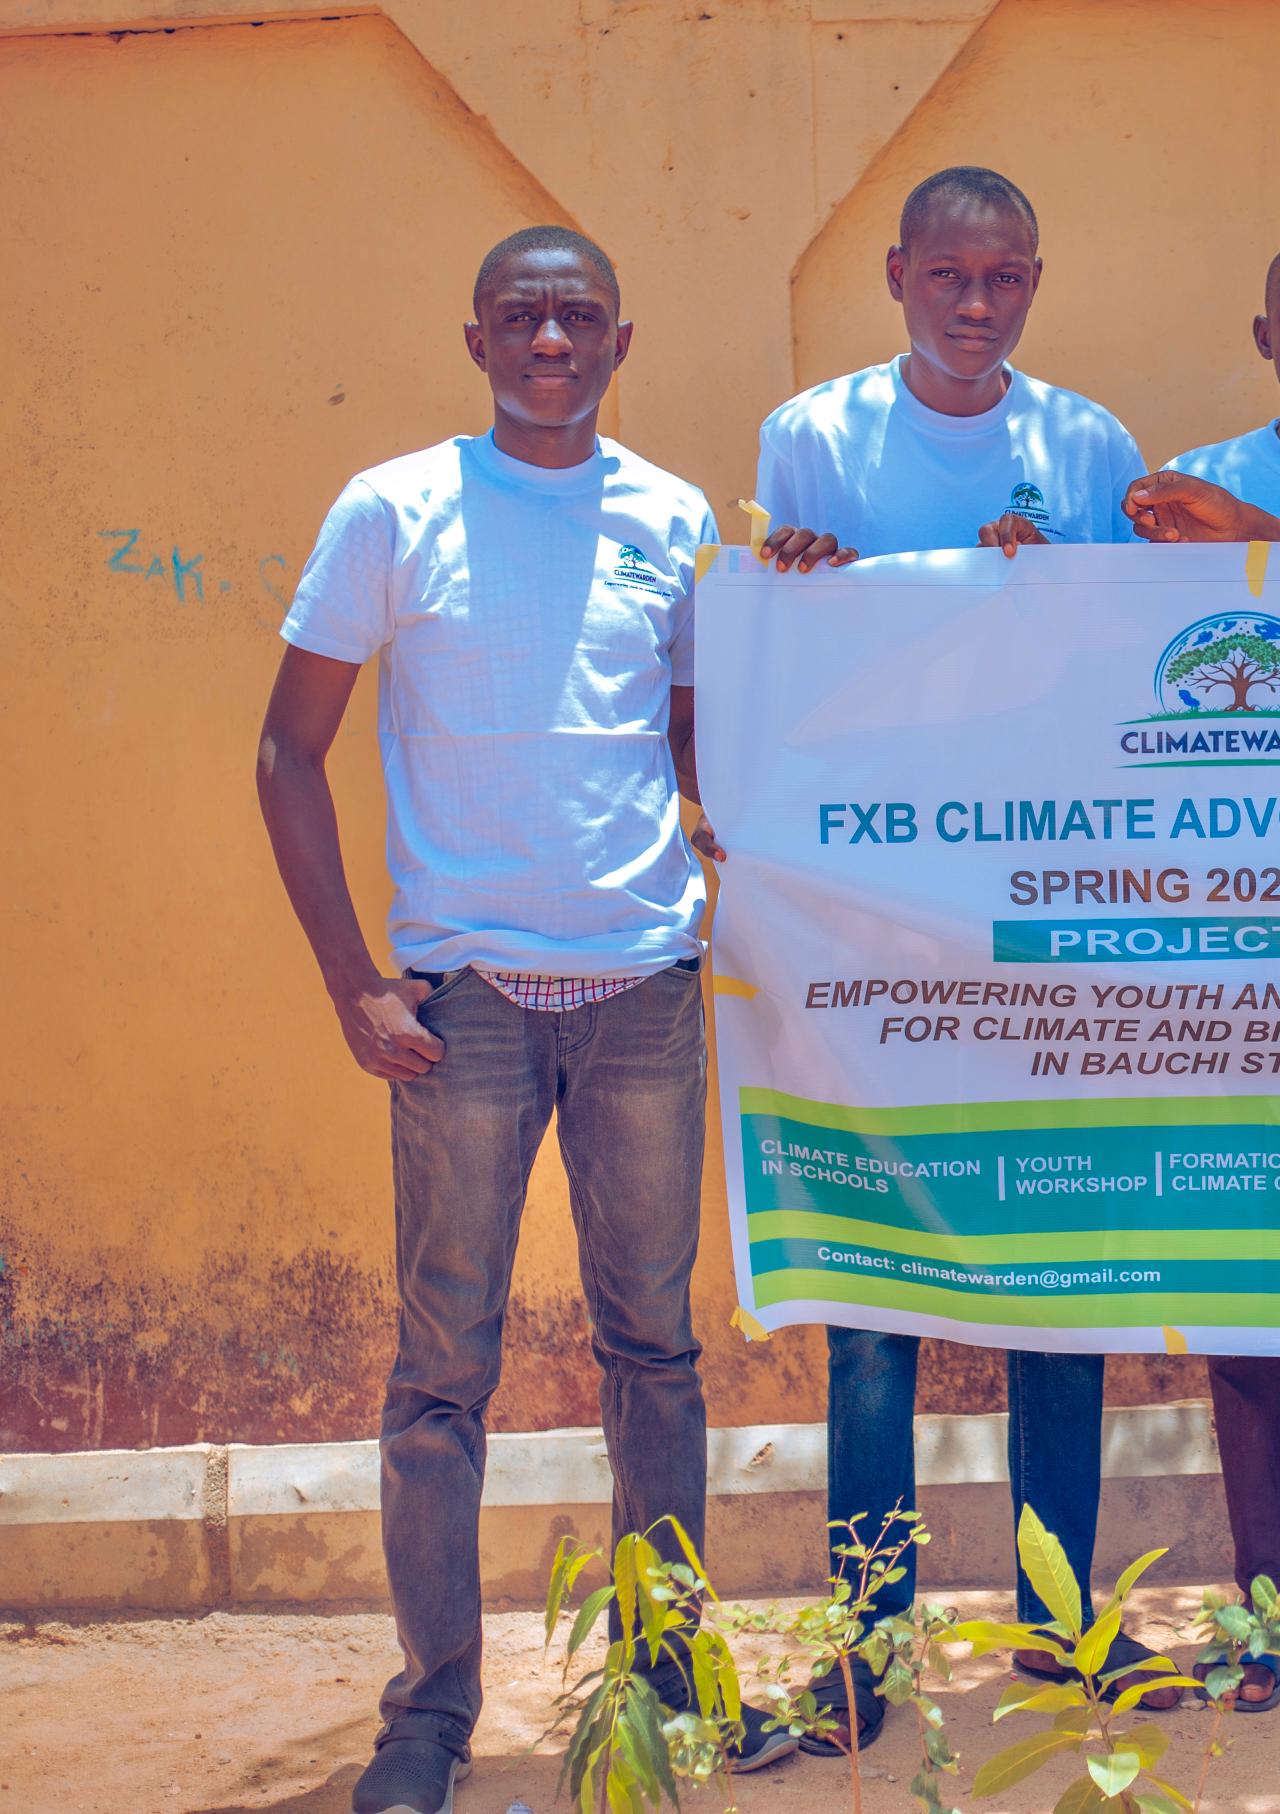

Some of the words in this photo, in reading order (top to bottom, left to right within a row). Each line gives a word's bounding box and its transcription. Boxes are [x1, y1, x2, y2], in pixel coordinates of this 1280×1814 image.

[614, 569, 657, 583] CLIMATEWARDEN
[820, 803, 918, 844] FXB
[936, 799, 1155, 842] CLIMATE
[1010, 869, 1189, 905] SPRING
[805, 980, 1076, 1008] EMPOWERING
[1091, 985, 1224, 1009] YOUTH
[880, 1016, 960, 1044] FOR
[974, 1017, 1140, 1041] CLIMATE
[1148, 1020, 1231, 1041] AND
[1031, 1052, 1069, 1075] IN
[1080, 1052, 1230, 1075] BAUCHI
[761, 1139, 850, 1167] CLIMATE
[855, 1157, 981, 1178] EDUCATION
[1016, 1156, 1091, 1172] YOUTH
[762, 1160, 782, 1174] IN
[790, 1161, 889, 1193] SCHOOLS
[1016, 1176, 1147, 1194] WORKSHOP
[1172, 1175, 1267, 1191] CLIMATE
[818, 1247, 896, 1271] Contact:
[901, 1261, 1161, 1289] climatewarden@gmail.com
